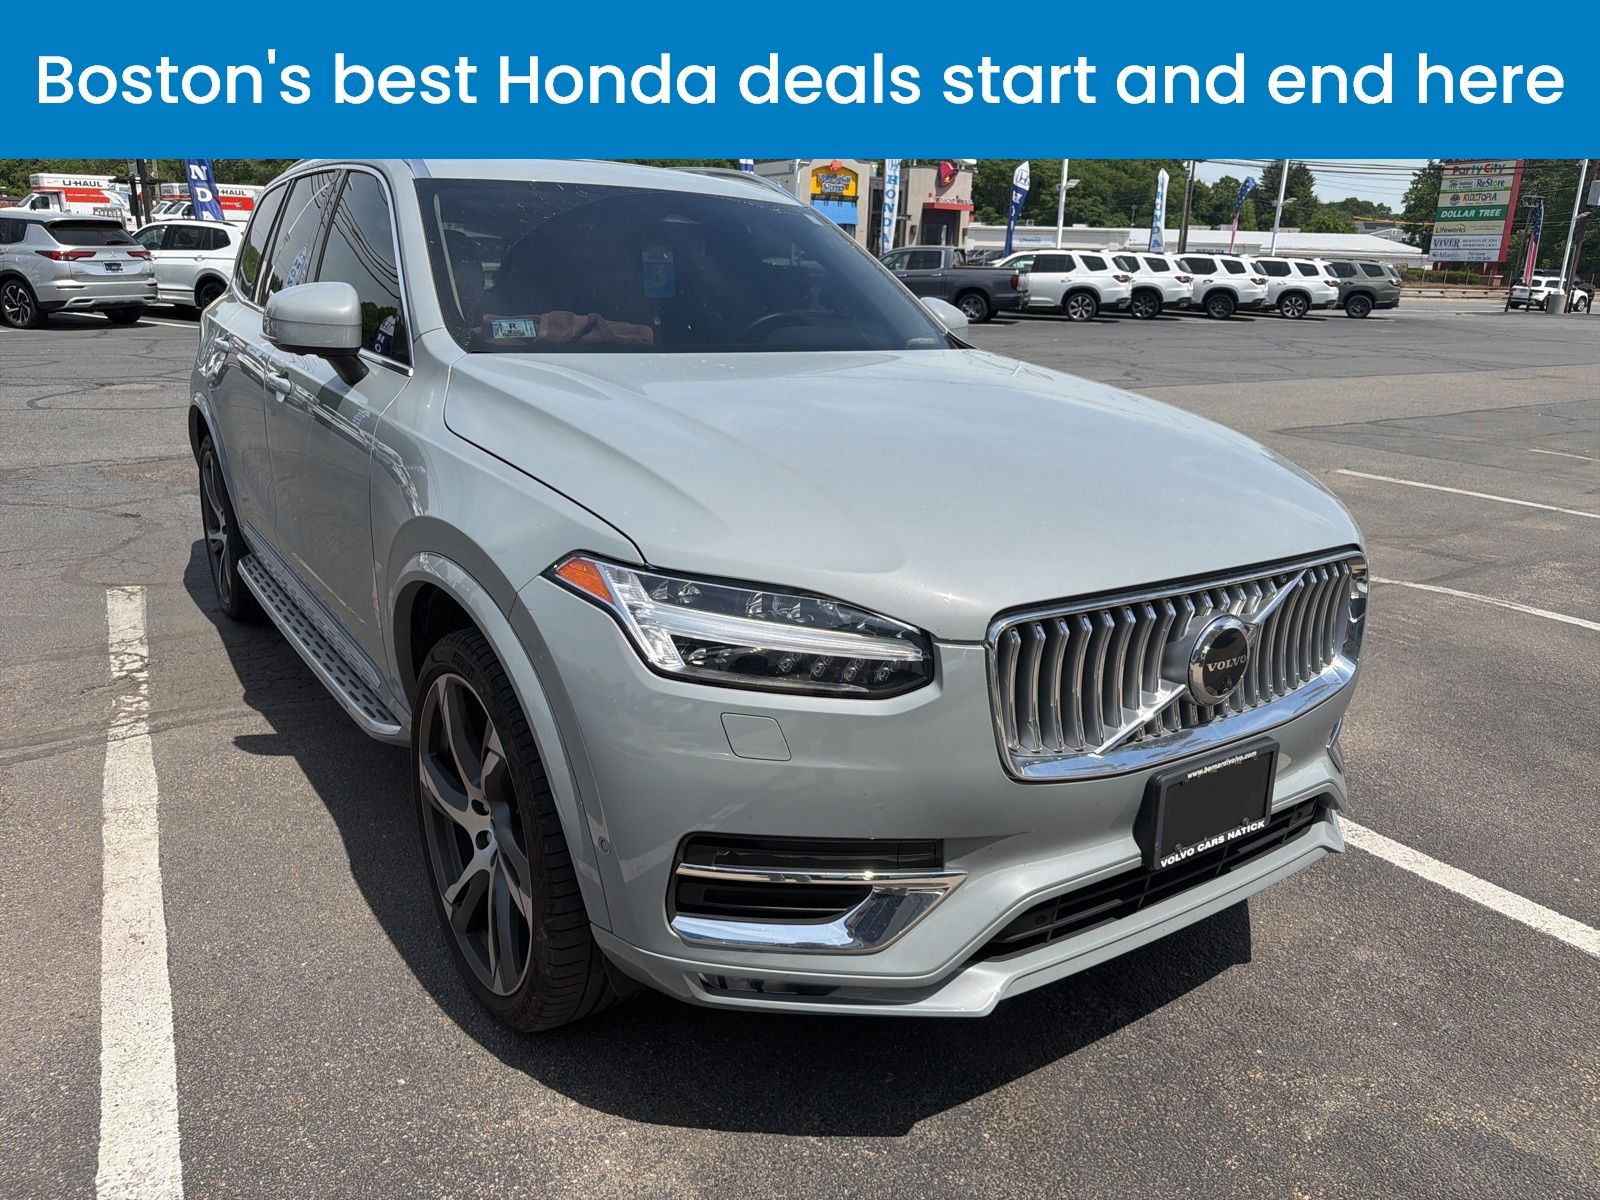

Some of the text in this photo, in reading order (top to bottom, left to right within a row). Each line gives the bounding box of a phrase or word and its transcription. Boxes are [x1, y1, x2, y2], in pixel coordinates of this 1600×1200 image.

[1453, 163, 1505, 175] Party City
[62, 180, 103, 188] U-HAUL
[1476, 178, 1505, 188] ReStore
[883, 175, 898, 243] HONDA
[1441, 209, 1502, 218] DOLLAR TREE
[1435, 226, 1466, 234] Lifeworks
[1206, 655, 1247, 673] VOLVO
[1160, 820, 1265, 868] VOLVO CARS NATICK
